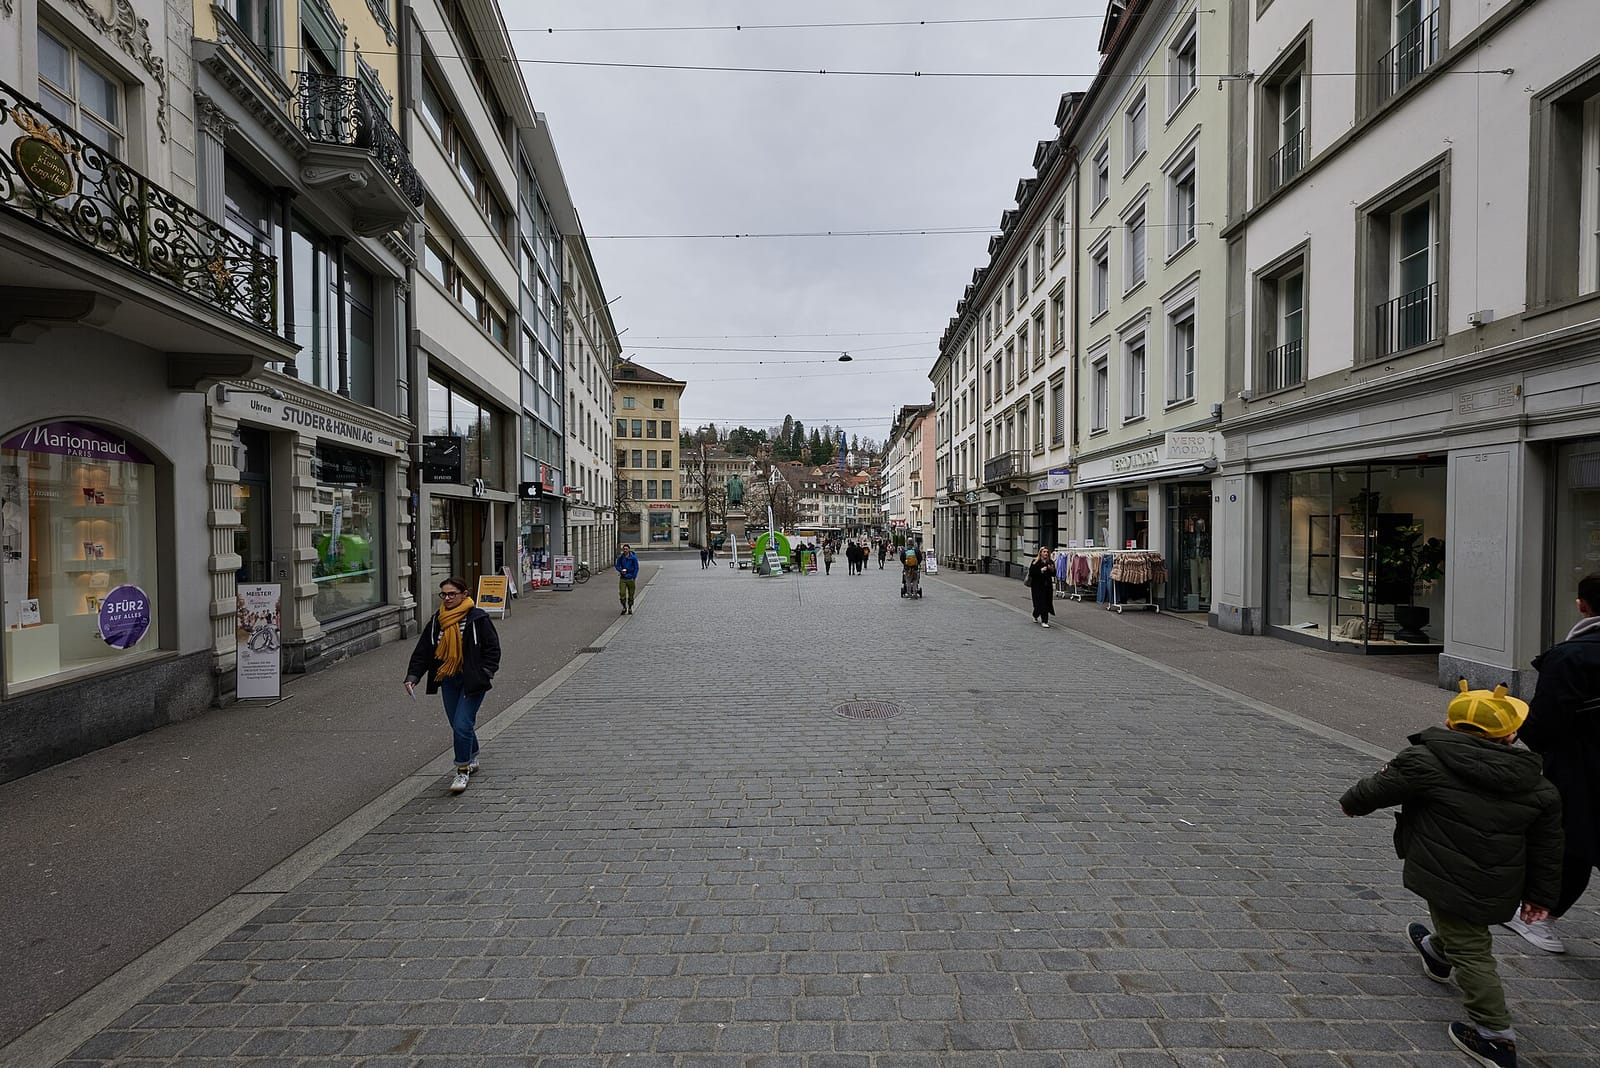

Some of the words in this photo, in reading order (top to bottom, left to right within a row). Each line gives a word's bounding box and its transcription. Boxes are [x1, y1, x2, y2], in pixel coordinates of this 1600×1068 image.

[250, 400, 272, 414] Uhren
[21, 426, 126, 455] Marionnaud
[1172, 436, 1205, 446] VERO
[67, 448, 92, 457] PARIS
[1171, 445, 1206, 455] MODA
[107, 603, 114, 613] 3
[137, 600, 144, 610] 2
